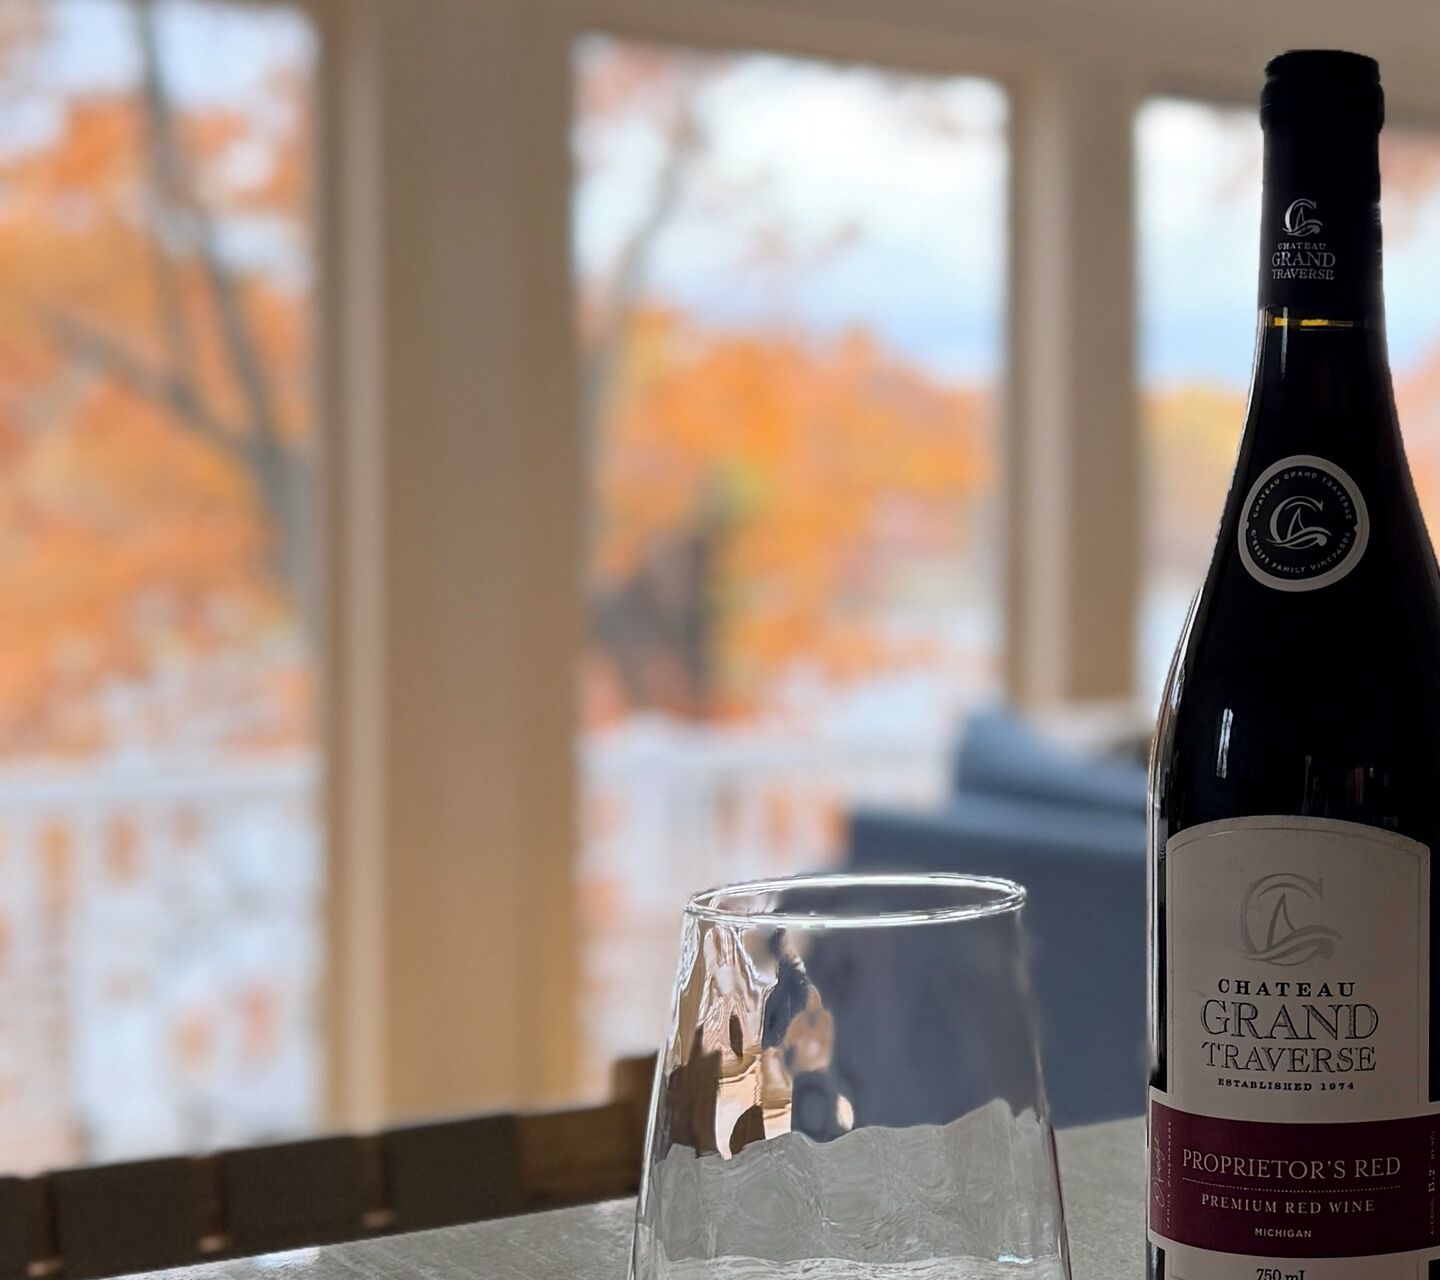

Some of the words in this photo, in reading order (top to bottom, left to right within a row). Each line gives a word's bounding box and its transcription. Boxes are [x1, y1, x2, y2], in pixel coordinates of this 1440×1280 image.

[1277, 242, 1327, 251] CHATEAU
[1271, 251, 1336, 267] GRAND
[1272, 269, 1335, 280] TRAVERSE
[1252, 478, 1280, 518] CHATEAU
[1283, 471, 1317, 480] GRAND
[1321, 477, 1352, 519] TRAVERSE
[1271, 562, 1305, 574] FAMILY
[1217, 978, 1356, 997] CHATEAU
[1200, 998, 1379, 1040] GRAND
[1201, 1041, 1376, 1073] TRAVERSE
[1217, 1077, 1313, 1091] ESTABLISHED
[1320, 1082, 1354, 1091] 1974
[1182, 1148, 1346, 1180] PROPRIETOR'S
[1354, 1156, 1401, 1178] RED
[1201, 1193, 1277, 1214] PREMIUM
[1285, 1200, 1321, 1214] RED
[1329, 1199, 1375, 1213] WINE
[1254, 1227, 1312, 1238] MICHIGAN
